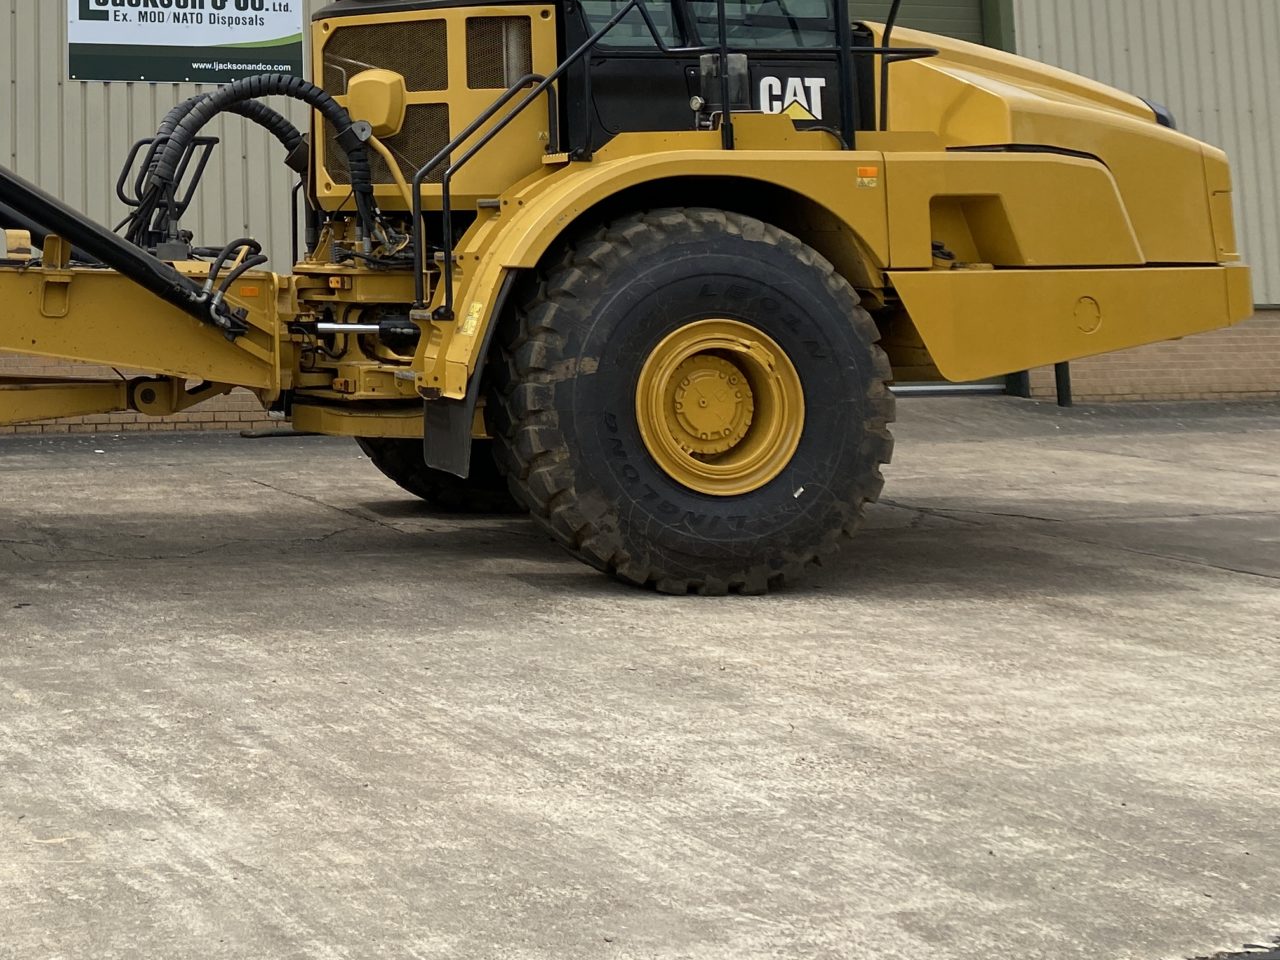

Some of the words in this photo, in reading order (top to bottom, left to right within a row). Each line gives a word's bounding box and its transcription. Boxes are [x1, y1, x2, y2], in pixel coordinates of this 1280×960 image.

[272, 1, 293, 13] Ltd.
[113, 10, 132, 23] Ex.
[208, 12, 265, 27] Disposals
[192, 61, 292, 72] www.ljacksonandco.com
[760, 76, 826, 120] CAT
